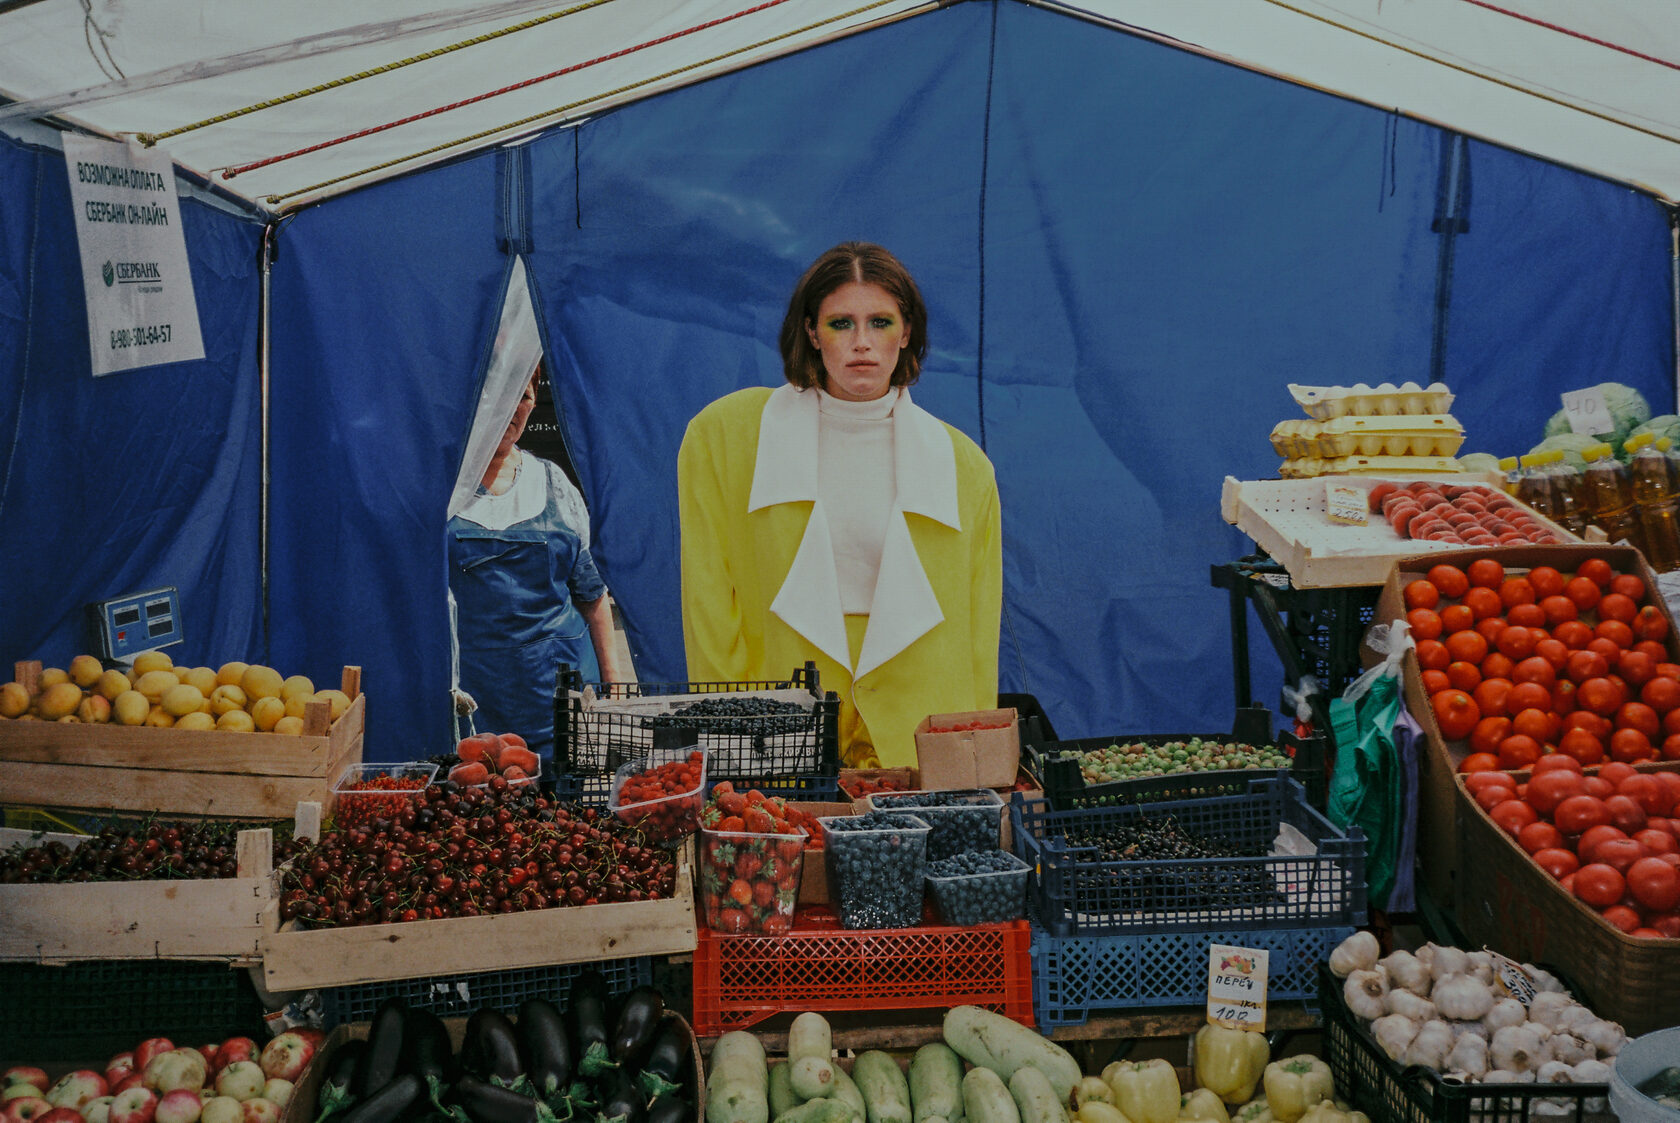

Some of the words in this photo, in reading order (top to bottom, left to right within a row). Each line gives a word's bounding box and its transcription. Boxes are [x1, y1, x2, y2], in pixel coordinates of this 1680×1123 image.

[77, 161, 130, 188] ВОЗМОЖНА
[130, 169, 166, 192] ОПЛАТА
[86, 200, 127, 224] СБЕРБАНК
[128, 201, 169, 226] ОН-ЛАЙН
[117, 262, 161, 279] СБЕРБАНК
[1216, 1006, 1249, 1021] 100
